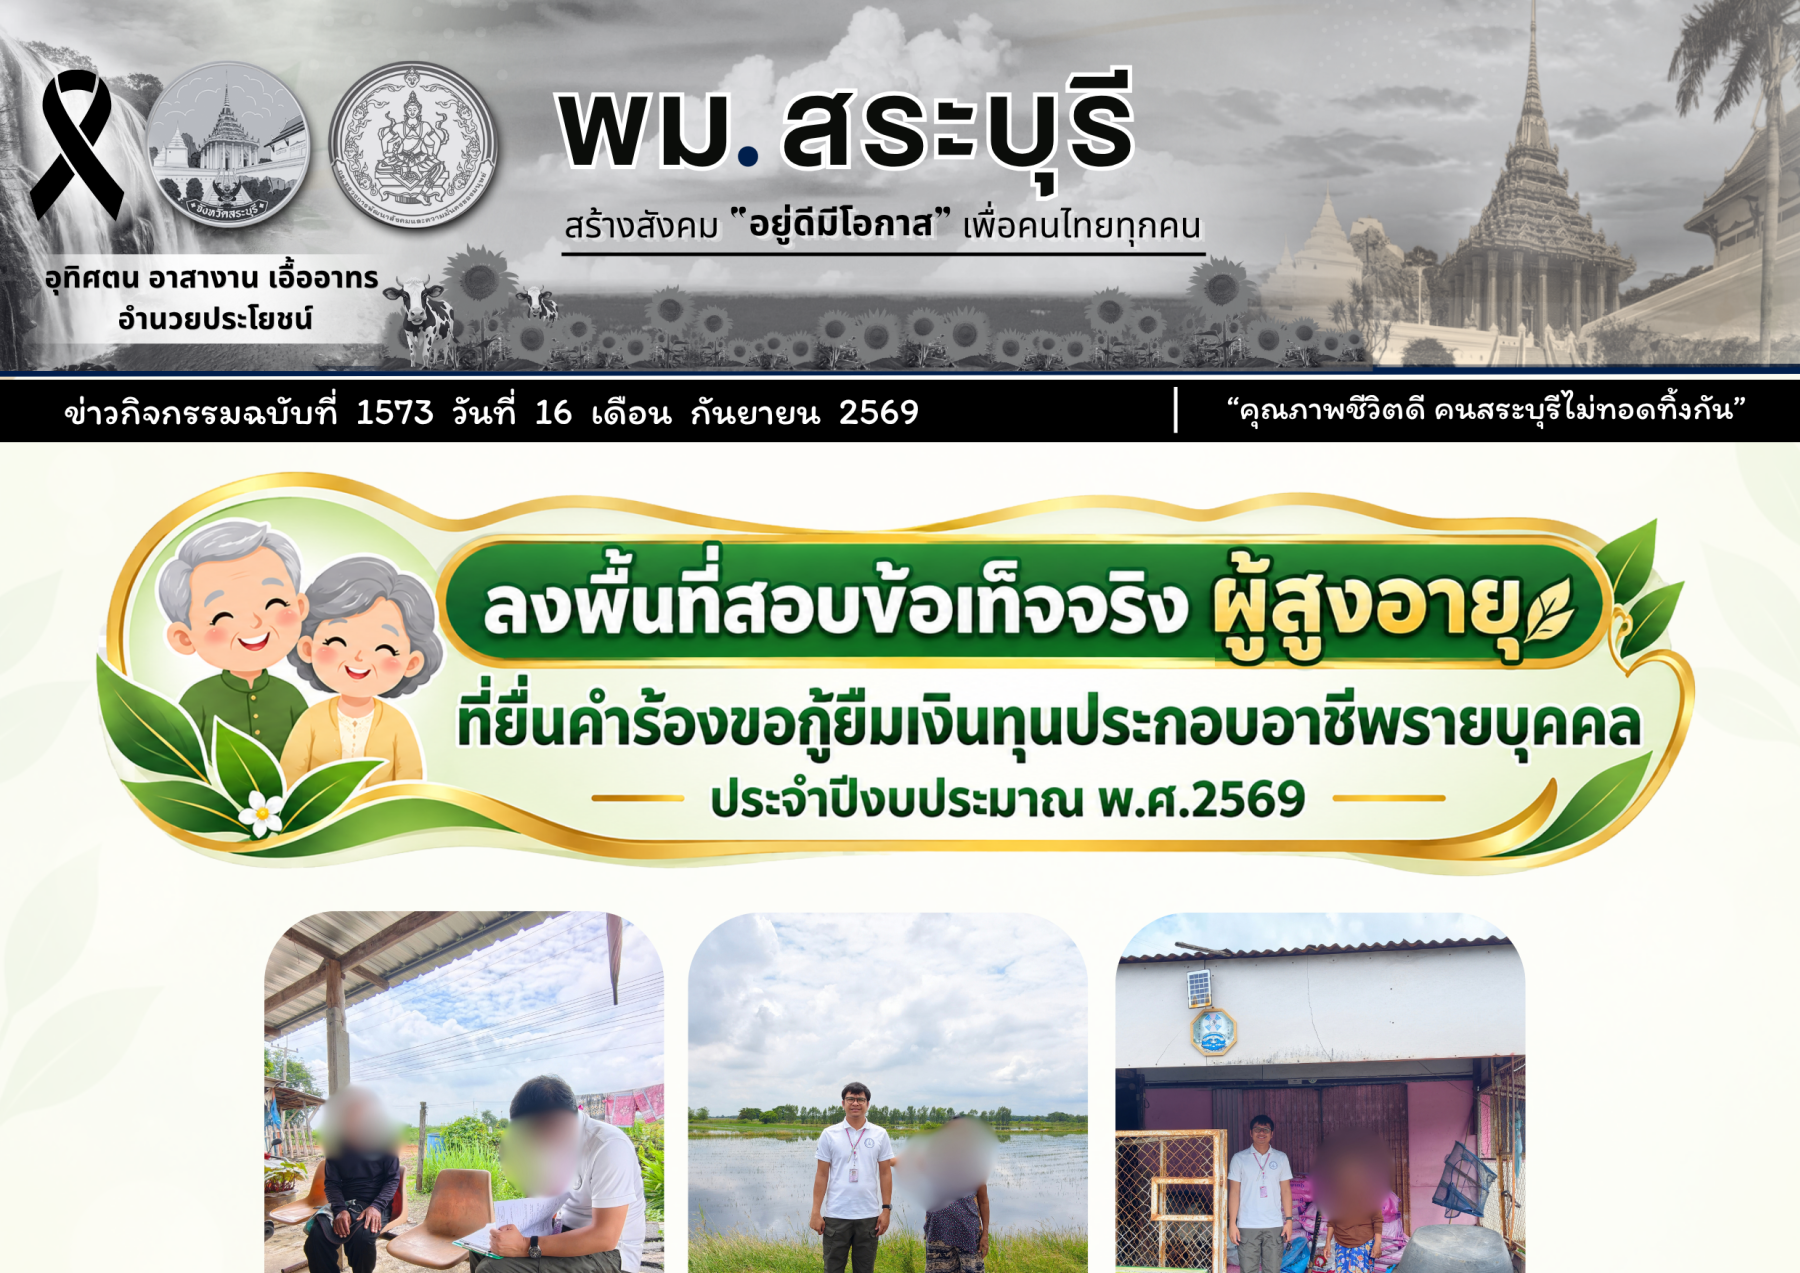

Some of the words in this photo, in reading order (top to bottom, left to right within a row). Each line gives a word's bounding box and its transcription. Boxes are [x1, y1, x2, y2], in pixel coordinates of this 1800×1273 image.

[557, 95, 760, 168] พม.
[783, 68, 1132, 198] สระบุรี
[196, 203, 259, 219] จังหวัดสระบุรี
[337, 170, 487, 225] กระทรวงการพัฒนาสังคมและความมั่นคงของมนุษย์
[564, 207, 718, 238] สร้างสังคม
[964, 200, 1201, 248] เพื่อคนไทยทุกคน
[45, 265, 139, 296] อุทิศตน
[149, 269, 258, 289] อาสางาน
[269, 256, 379, 289] เอื้ออาทร
[118, 303, 314, 330] อำนวยประโยชน์
[64, 388, 337, 425] ข่าวกิจกรรมฉบับที่
[357, 399, 434, 425] 1573
[452, 388, 516, 425] วันที่
[536, 399, 572, 425] 16
[592, 395, 673, 425] เดือน
[691, 396, 821, 425] กันยายน
[839, 399, 919, 425] 2569
[1227, 394, 1425, 430] “คุณภาพชีวิตดี
[1435, 387, 1746, 430] คนสระบุรีไม่ทอดทิ้งกัน”
[484, 545, 1190, 635] ลงพื้นที่สอบข้อเท็จจริง
[1212, 549, 1521, 662] ผู้สูงอายุ
[457, 675, 1642, 763] ที่ยื่นคำร้องขอกู้ยืมเงินทุนประกอบอาชีพรายบุคคล
[711, 773, 1084, 818] ประจำปีงบประมาณ
[1099, 779, 1306, 818] พ.ศ.2569
